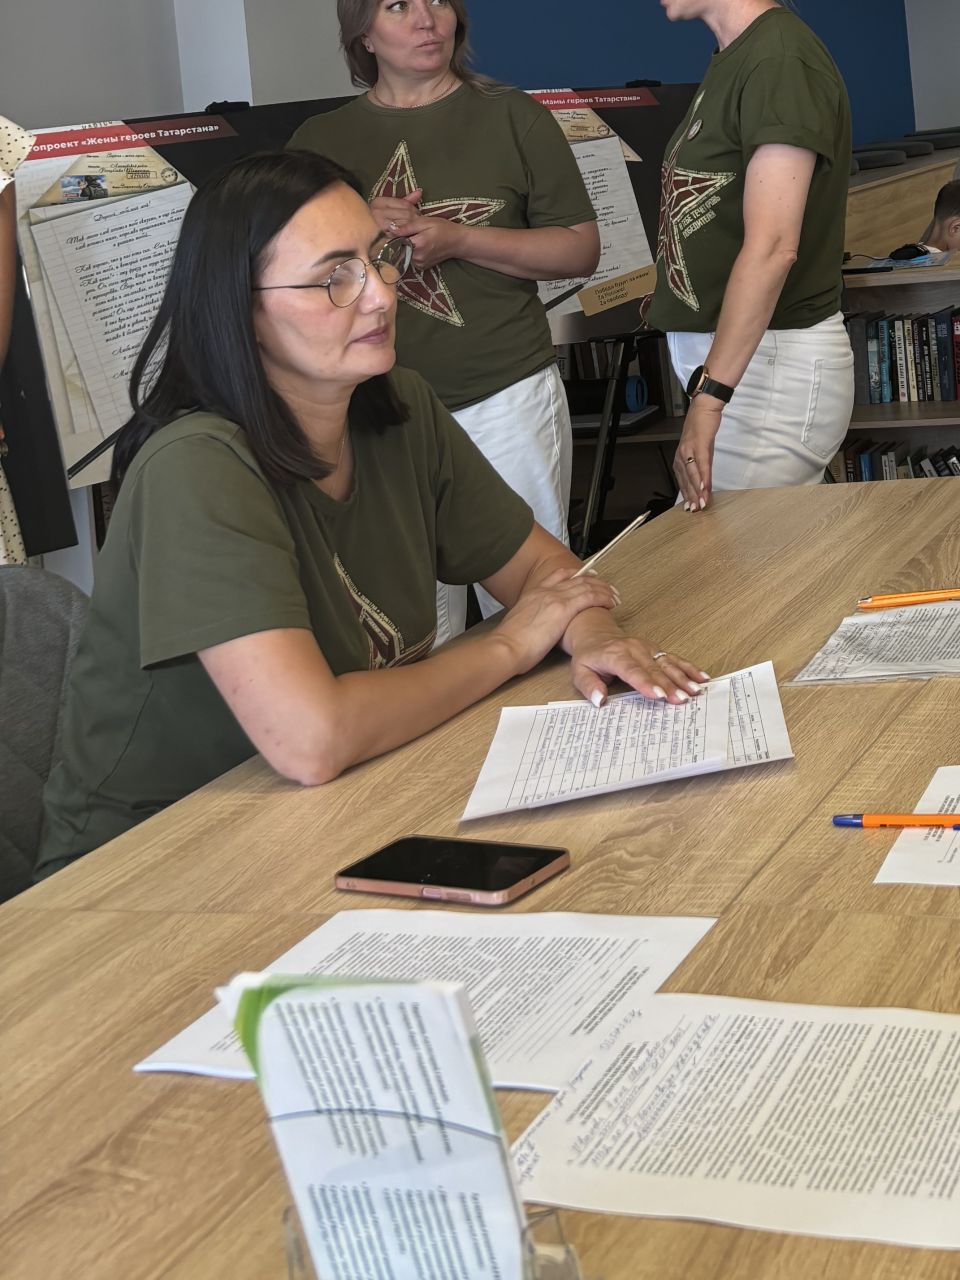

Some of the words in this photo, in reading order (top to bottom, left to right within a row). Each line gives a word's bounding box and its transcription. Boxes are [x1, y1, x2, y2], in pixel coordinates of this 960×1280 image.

[33, 140, 79, 152] опроект
[81, 136, 119, 147] «Жены
[120, 132, 157, 146] героев
[157, 124, 220, 138] Татарстана»
